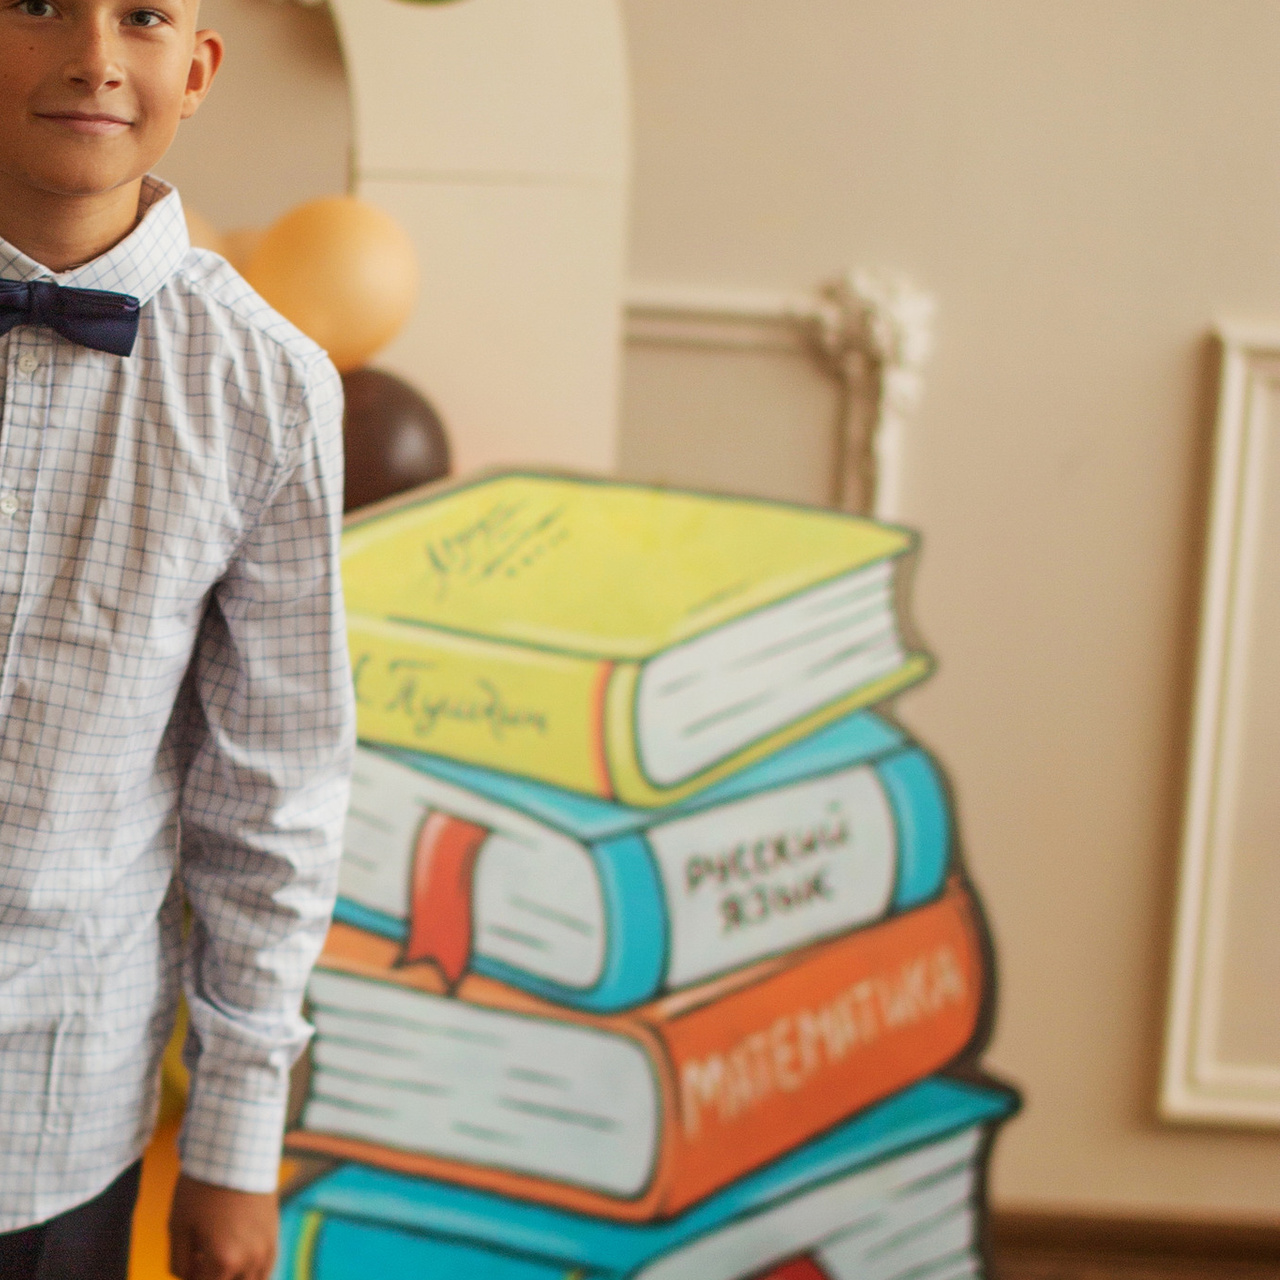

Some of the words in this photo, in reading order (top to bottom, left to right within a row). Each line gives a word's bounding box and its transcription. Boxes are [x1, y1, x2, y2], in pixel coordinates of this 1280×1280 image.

[686, 801, 848, 893] РУССКИЙ
[721, 868, 834, 934] ЯЗЫК
[683, 948, 964, 1140] МАТЕМАТИКА
